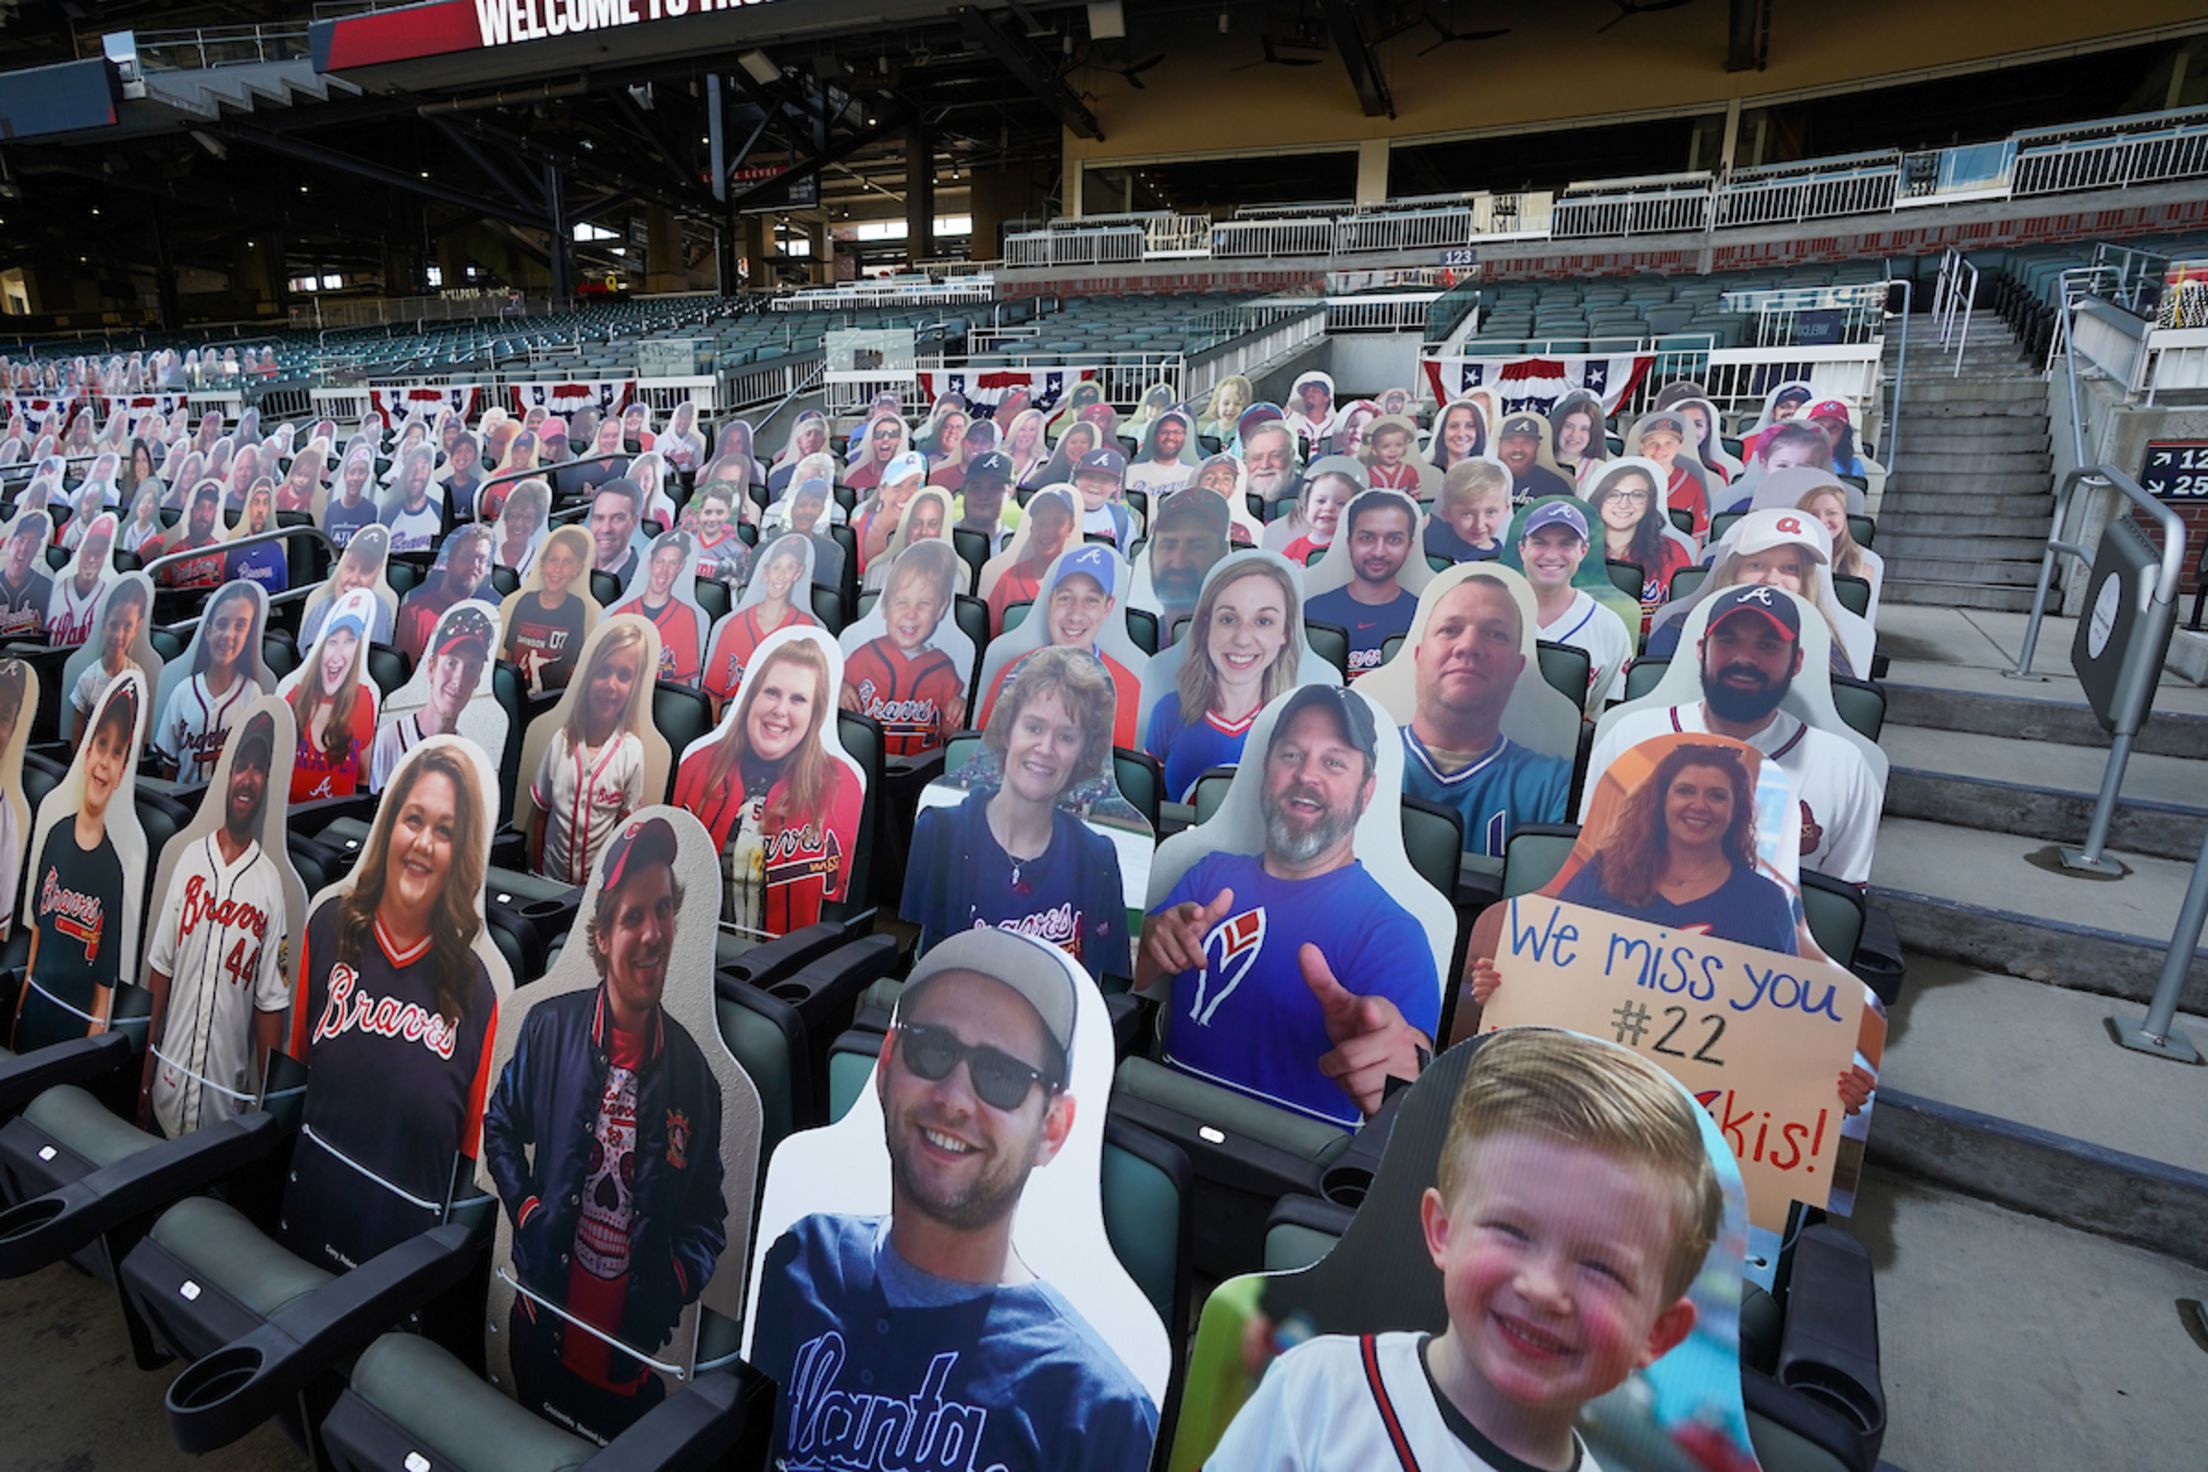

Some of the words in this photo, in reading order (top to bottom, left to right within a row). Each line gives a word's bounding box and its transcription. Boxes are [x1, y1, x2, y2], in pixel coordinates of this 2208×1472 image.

[1446, 250, 1472, 265] 123
[2173, 475, 2208, 496] 25
[1737, 586, 1773, 607] A
[549, 630, 569, 650] 07
[308, 775, 334, 800] A
[225, 937, 260, 991] 44
[1511, 896, 1579, 968] We
[1603, 931, 1724, 1002] miss
[1728, 963, 1843, 1023] you
[312, 961, 460, 1061] Braves
[1609, 998, 1728, 1068] #22
